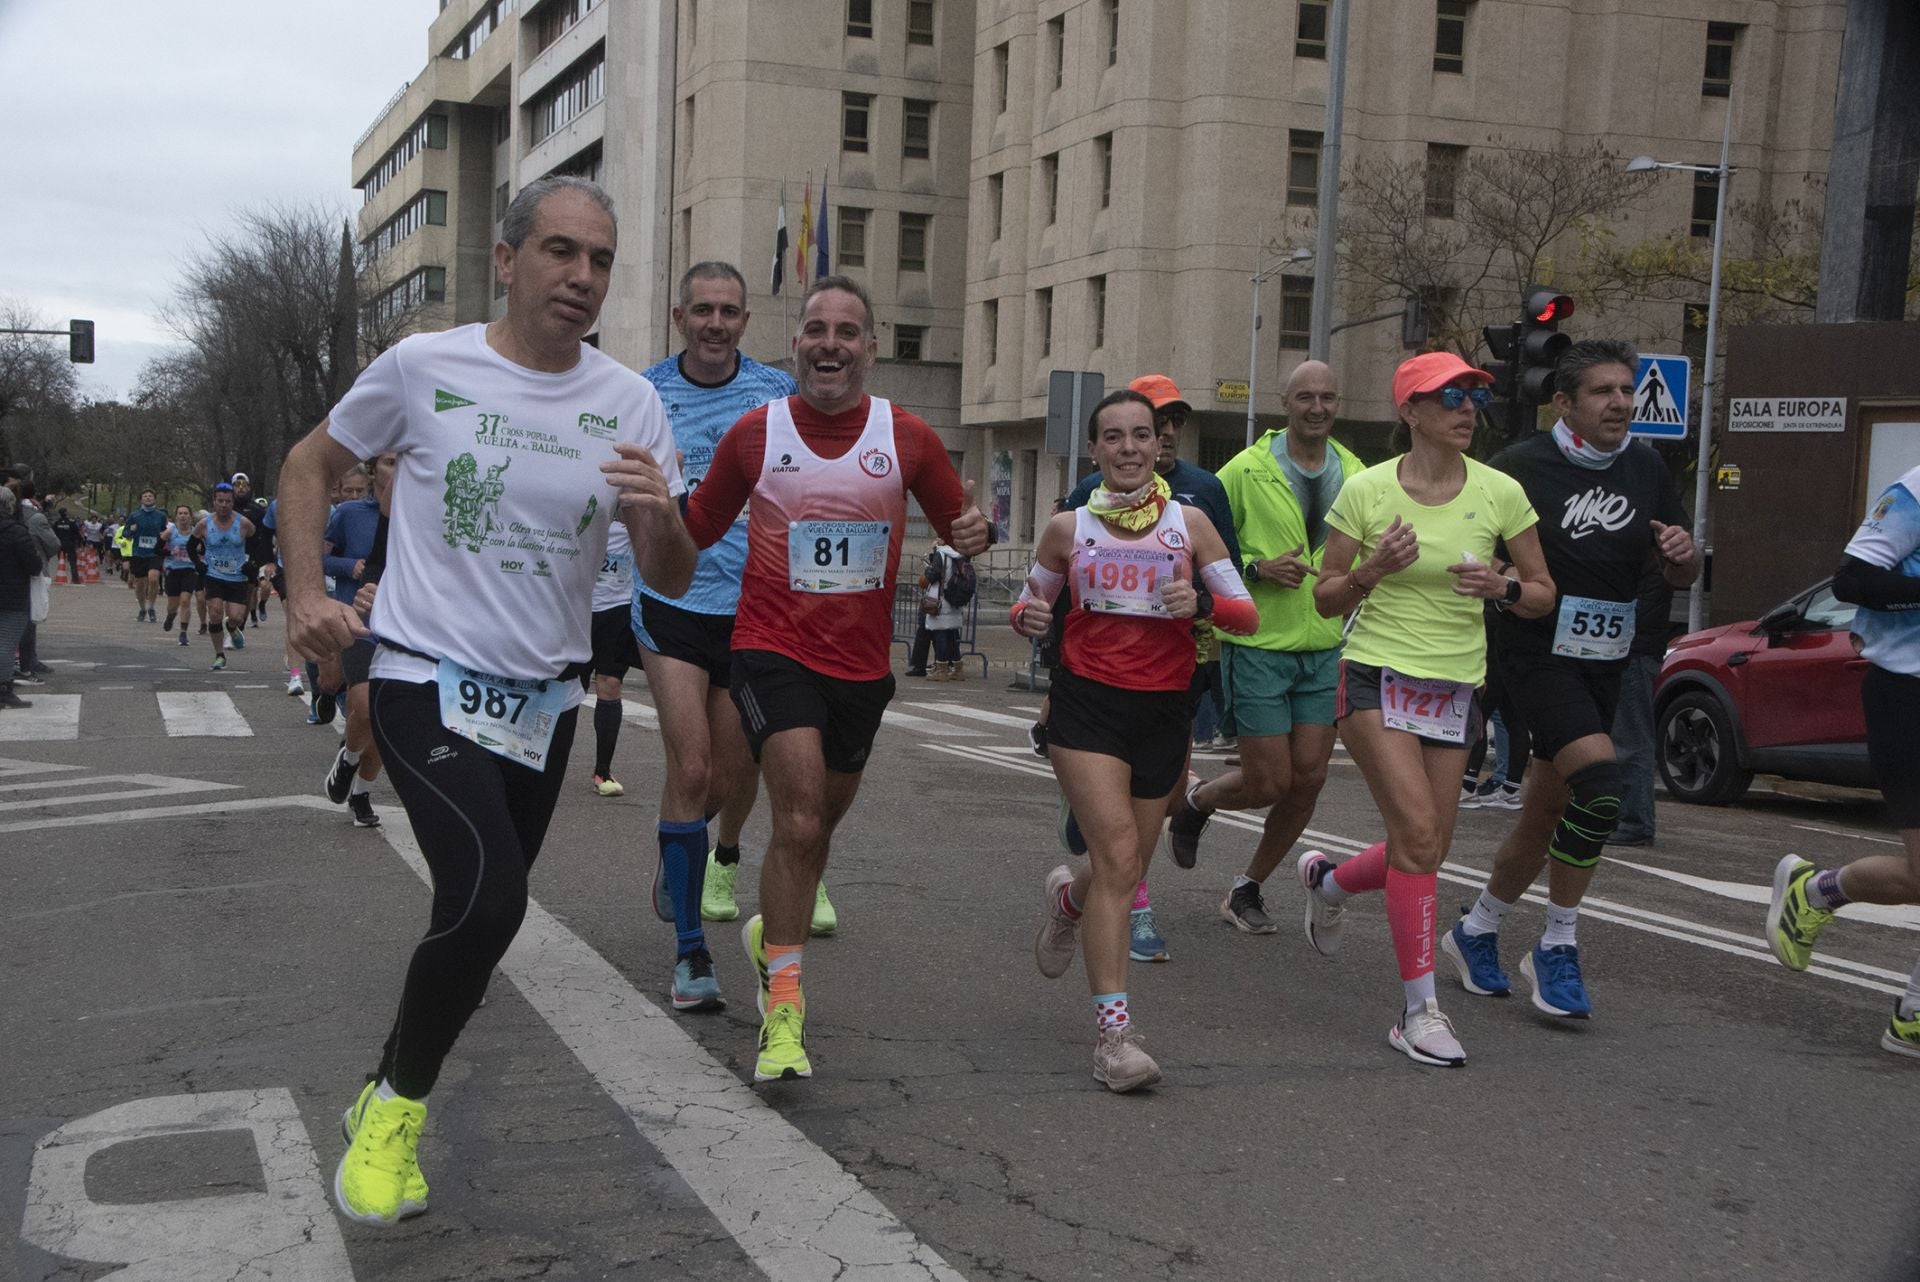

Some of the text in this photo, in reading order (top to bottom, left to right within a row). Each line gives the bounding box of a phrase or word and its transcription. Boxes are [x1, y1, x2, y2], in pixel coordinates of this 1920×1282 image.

[1733, 401, 1842, 417] SALA EUROPA
[1731, 421, 1774, 429] EXPOSICIONES
[500, 427, 559, 444] CROSS POPULAR
[475, 434, 519, 449] VUELTA
[531, 441, 582, 461] BALUARTE
[509, 521, 531, 534] Otra
[489, 536, 504, 546] con
[507, 536, 515, 547] la
[814, 537, 849, 566] 81
[501, 559, 524, 570] HOY
[1083, 562, 1156, 593] 1981
[1571, 611, 1624, 639] 535
[459, 680, 529, 725] 987
[1385, 684, 1451, 718] 1727
[1443, 729, 1460, 737] HOY
[524, 748, 542, 762] HOY
